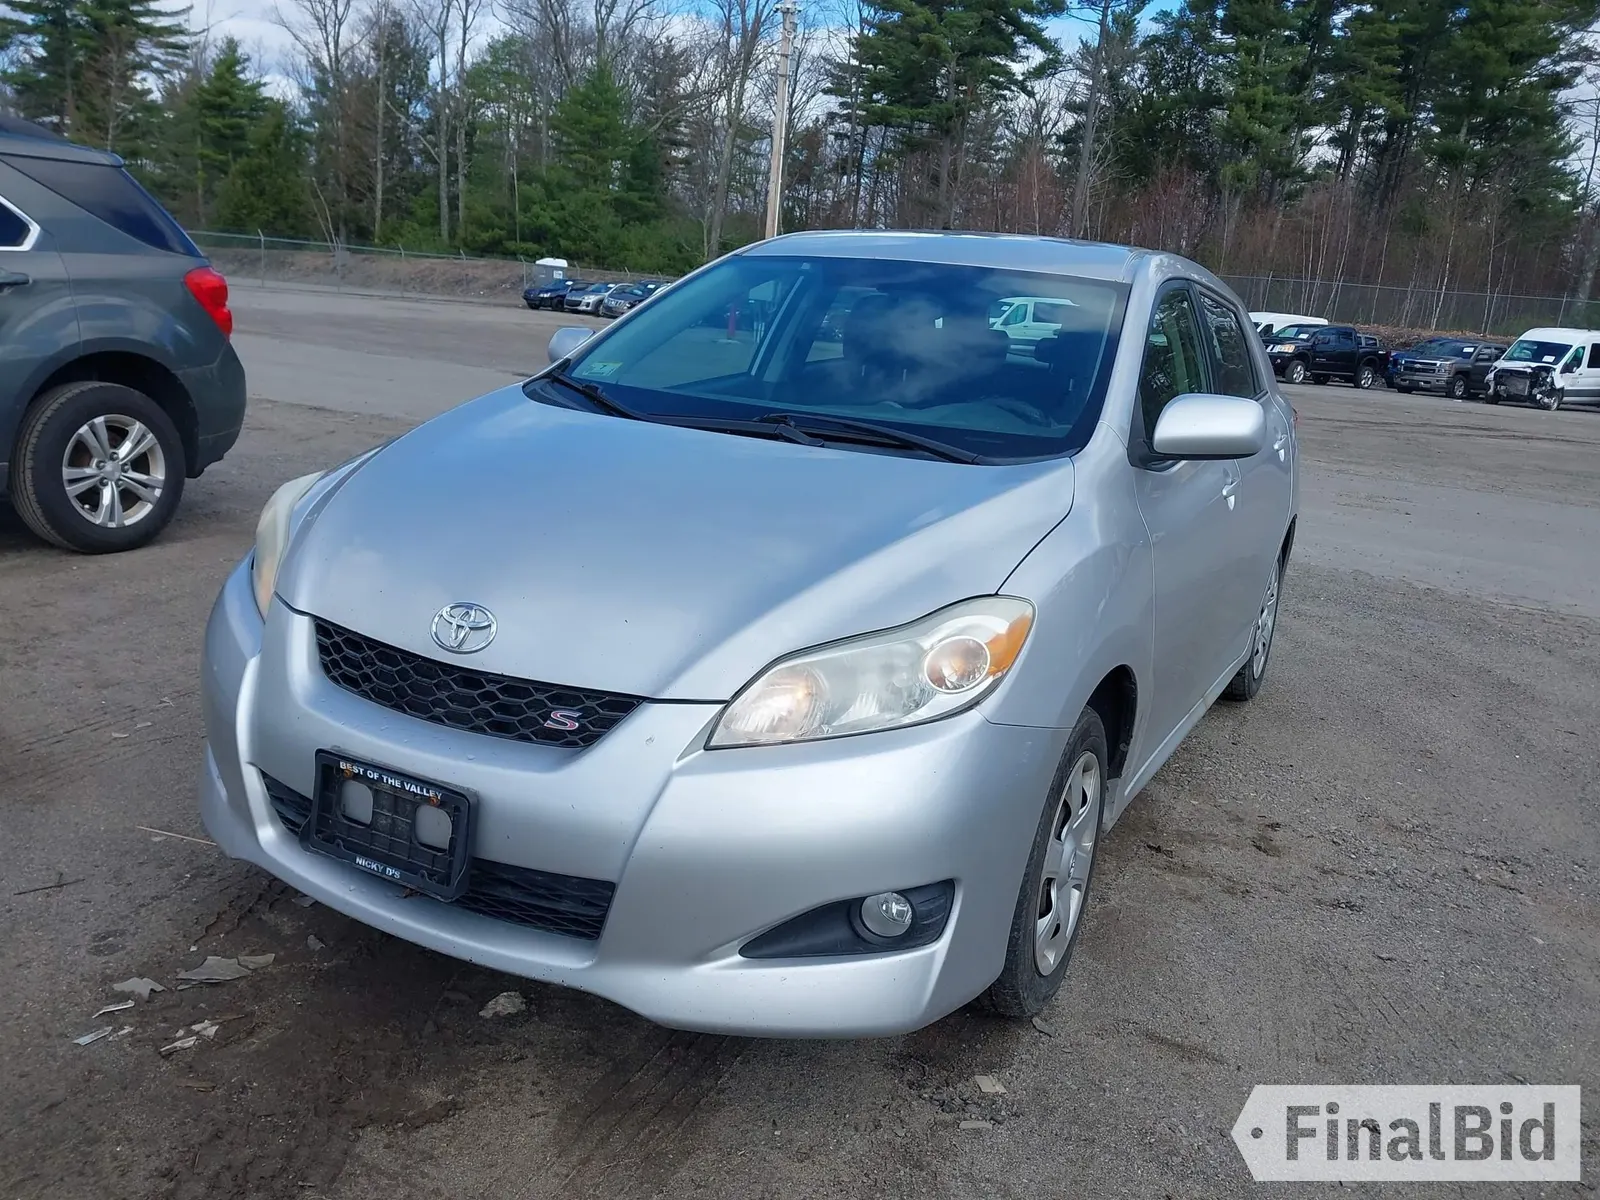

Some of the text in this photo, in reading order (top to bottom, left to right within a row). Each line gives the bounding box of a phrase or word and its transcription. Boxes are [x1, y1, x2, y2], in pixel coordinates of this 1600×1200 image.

[544, 711, 582, 730] S
[340, 761, 442, 800] BEST OF THE VALLEY
[356, 856, 401, 879] NICKY D'S
